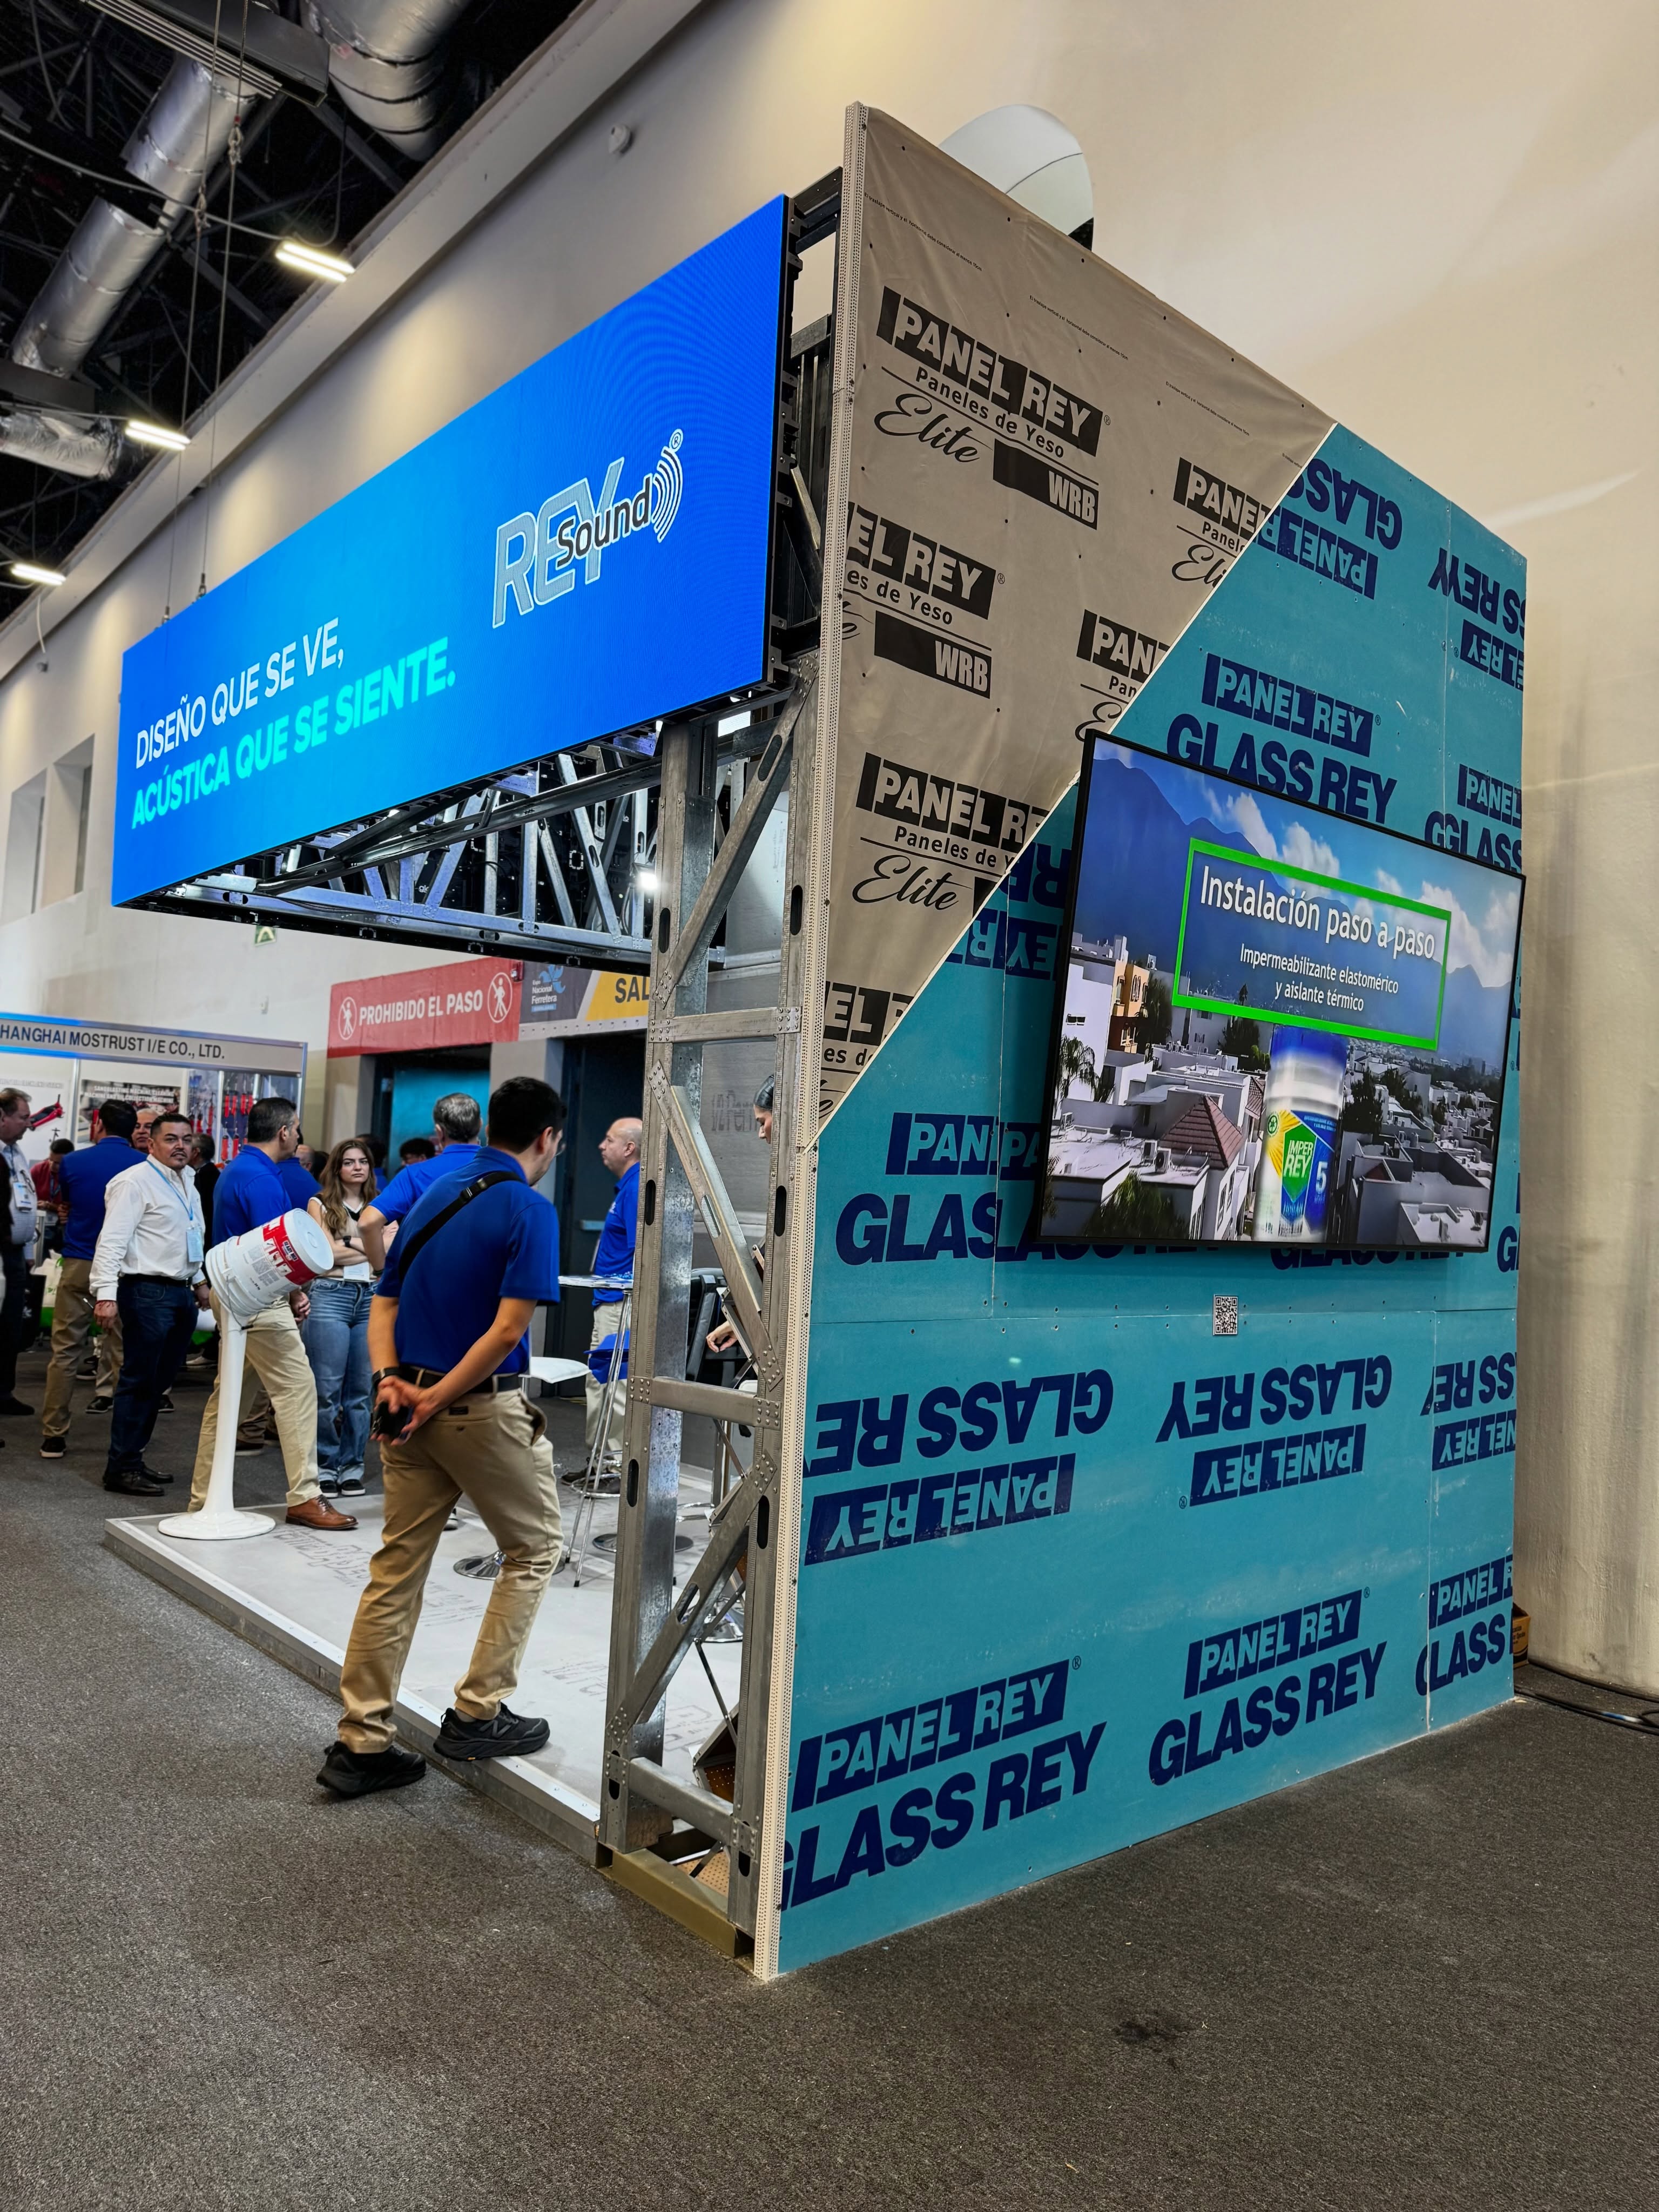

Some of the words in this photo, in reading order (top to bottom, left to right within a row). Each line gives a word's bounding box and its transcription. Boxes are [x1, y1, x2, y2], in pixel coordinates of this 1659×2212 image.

[893, 299, 1011, 401] PANEL
[874, 393, 994, 464] Elite
[915, 366, 989, 419] Paneles
[995, 413, 1017, 435] de
[1025, 423, 1064, 459] Yeso
[555, 471, 655, 570] Sound
[1048, 470, 1096, 525] WRB
[490, 456, 625, 630] REY
[1288, 522, 1366, 589] PANEL
[876, 581, 900, 603] de
[909, 591, 953, 625] Yeso
[135, 693, 206, 768] DISEÑO
[211, 662, 260, 726] QUE
[265, 644, 296, 698] SE
[303, 616, 345, 678] VE,
[935, 639, 988, 692] WRB
[1216, 665, 1306, 726] PANEL
[131, 754, 232, 831] ACÚSTICA
[235, 721, 289, 780] QUE
[293, 695, 330, 754] SE
[333, 635, 457, 738] SIENTE.
[1166, 713, 1315, 803] GLASS
[1318, 757, 1399, 825] REY
[1466, 773, 1522, 820] PANEL
[875, 766, 991, 834] PANEL
[894, 825, 969, 860] Paneles
[975, 848, 997, 868] de
[853, 854, 973, 911] Elite
[1201, 865, 1320, 932] Instalación
[1325, 908, 1372, 944] paso
[1377, 921, 1388, 948] a
[1393, 925, 1435, 960] paso
[531, 994, 557, 1004] Ferretera
[532, 984, 552, 994] Nacional
[1240, 943, 1337, 981] Impermeabilizante
[1339, 966, 1400, 994] elastomérico
[1274, 980, 1282, 1000] y
[1284, 981, 1325, 1004] aislante
[1327, 988, 1365, 1012] térmico
[359, 997, 426, 1027] PROHIBIDO
[427, 995, 444, 1018] EL
[446, 989, 484, 1015] PASO
[69, 1030, 145, 1052] MOSTRUST
[147, 1038, 166, 1054] I/E
[168, 1040, 195, 1060] CO.,
[199, 1043, 226, 1060] LTD.
[1283, 1155, 1312, 1178] REY
[1289, 1139, 1314, 1156] IMPER
[1315, 1161, 1328, 1193] 5
[1156, 1372, 1255, 1444] REY
[1260, 1354, 1393, 1426] GLASS
[1478, 1351, 1517, 1404] SS
[802, 1393, 909, 1478] RE
[915, 1368, 1114, 1460] GLASS
[1272, 1429, 1354, 1481] PANEL
[1439, 1426, 1480, 1464] REY
[824, 1491, 919, 1552] REY
[936, 1467, 1058, 1534] PANEL
[1437, 1567, 1499, 1617] PANEL
[1199, 1622, 1291, 1684] PANEL
[1148, 1672, 1300, 1786] GLASS
[1305, 1641, 1387, 1723] REY
[815, 1699, 961, 1799] PANEL
[982, 1721, 1108, 1832] REY
